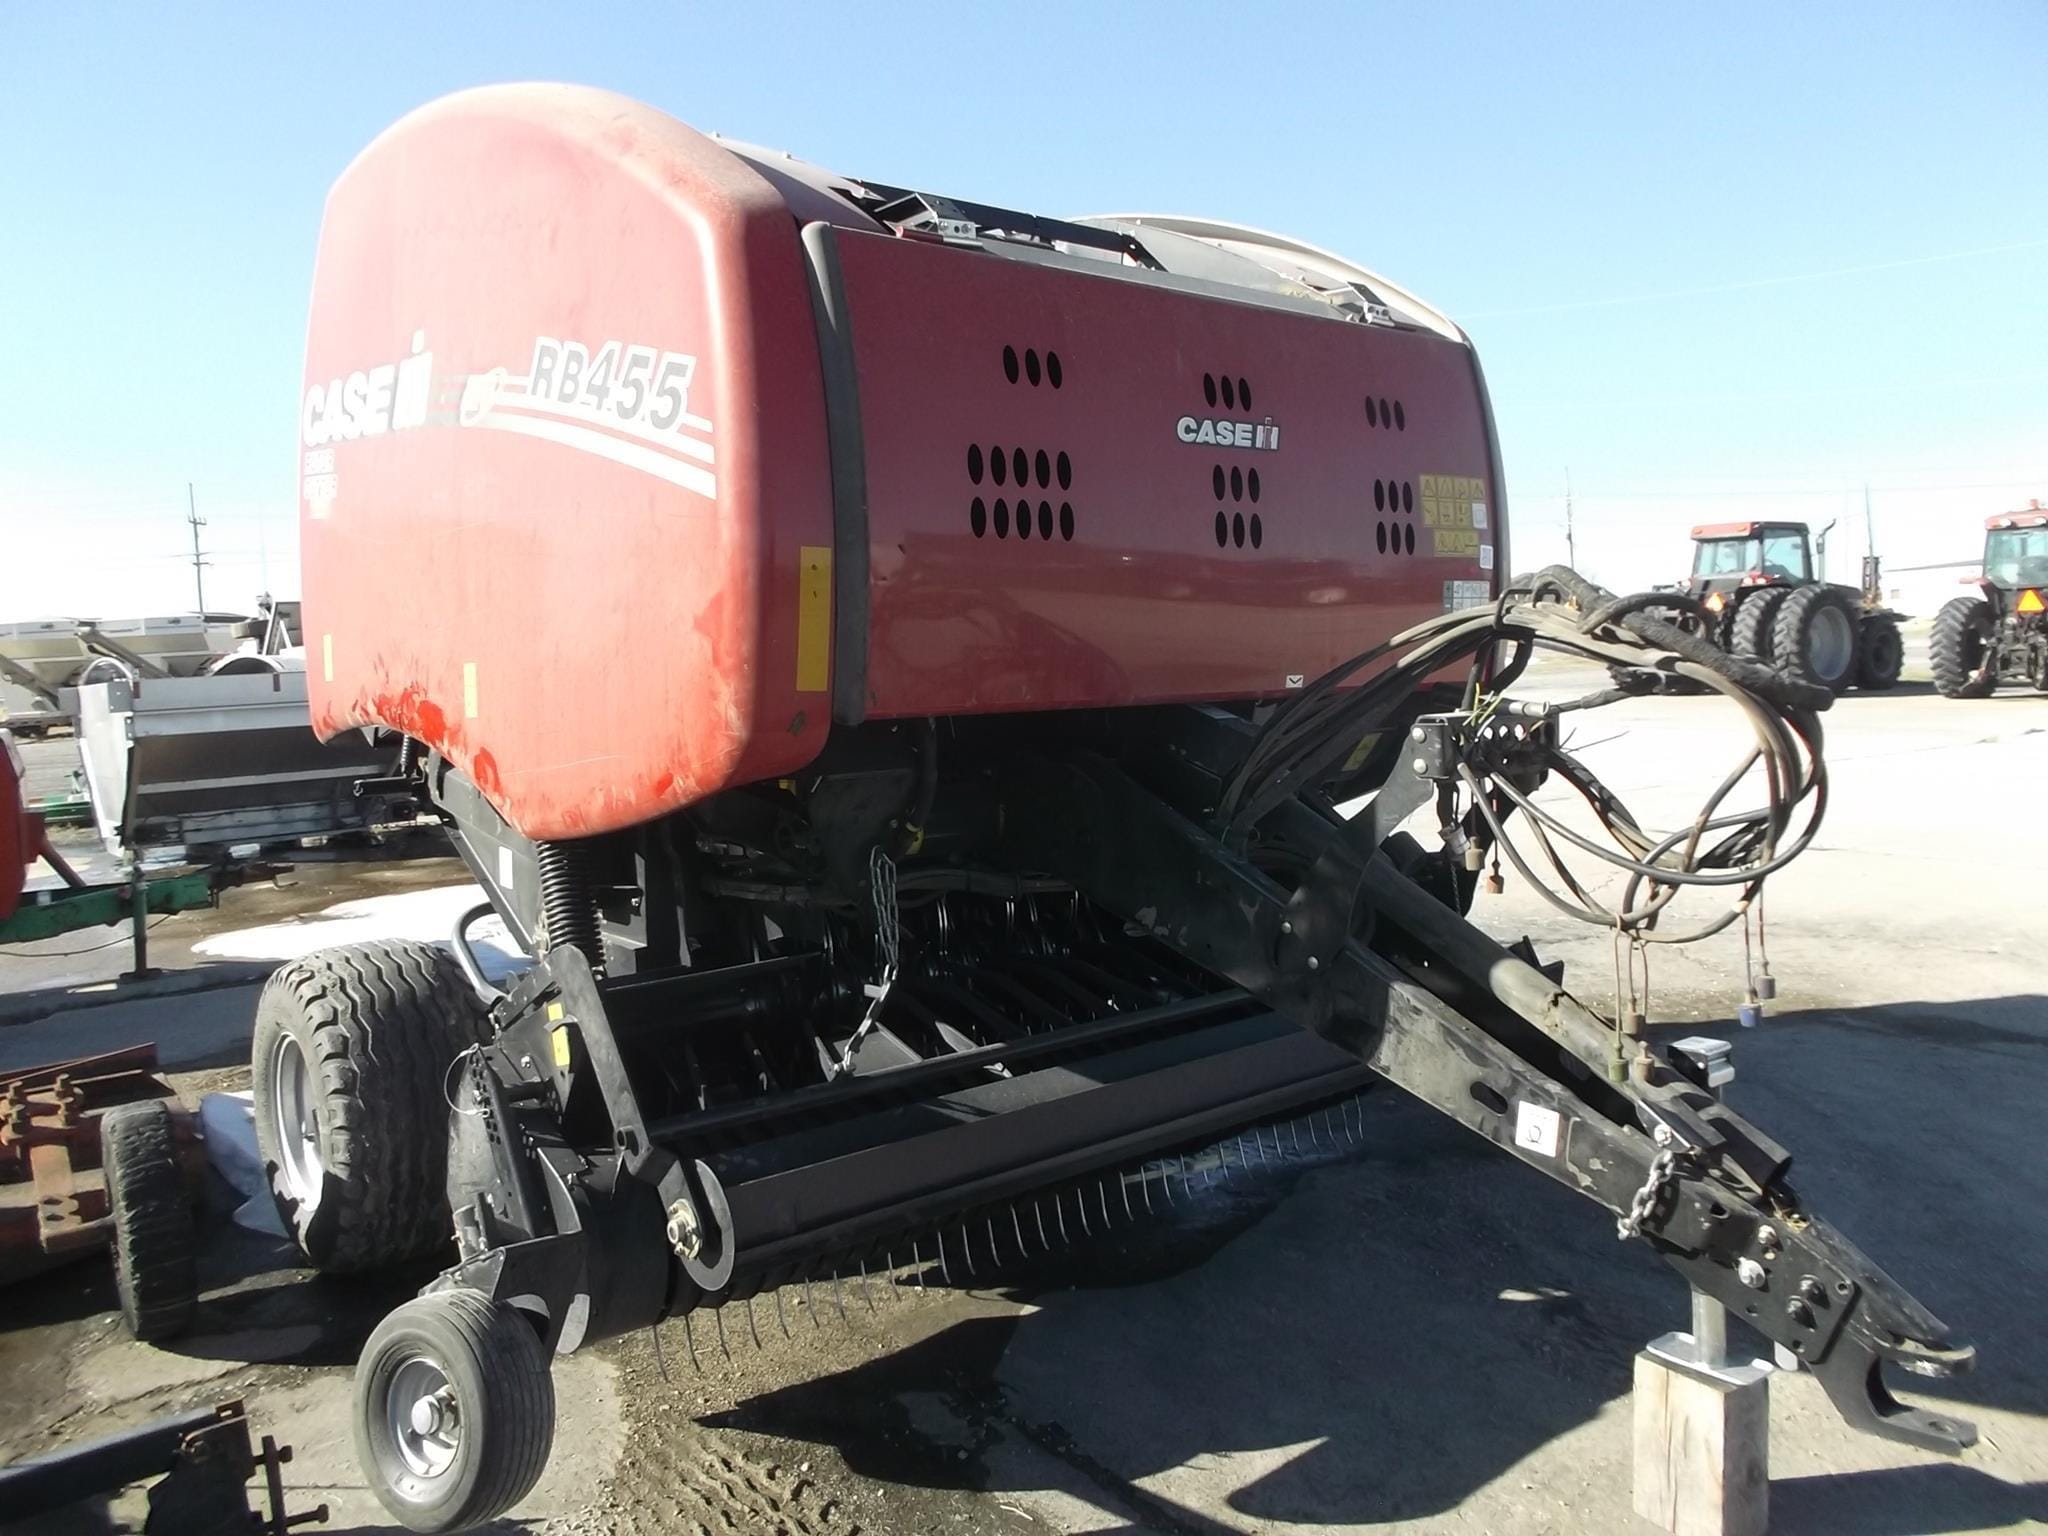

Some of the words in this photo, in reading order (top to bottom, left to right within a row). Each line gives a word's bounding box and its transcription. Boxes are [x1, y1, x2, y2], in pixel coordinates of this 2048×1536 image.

[303, 365, 395, 446] CASE
[530, 337, 696, 431] RB455
[1177, 416, 1253, 447] CASE
